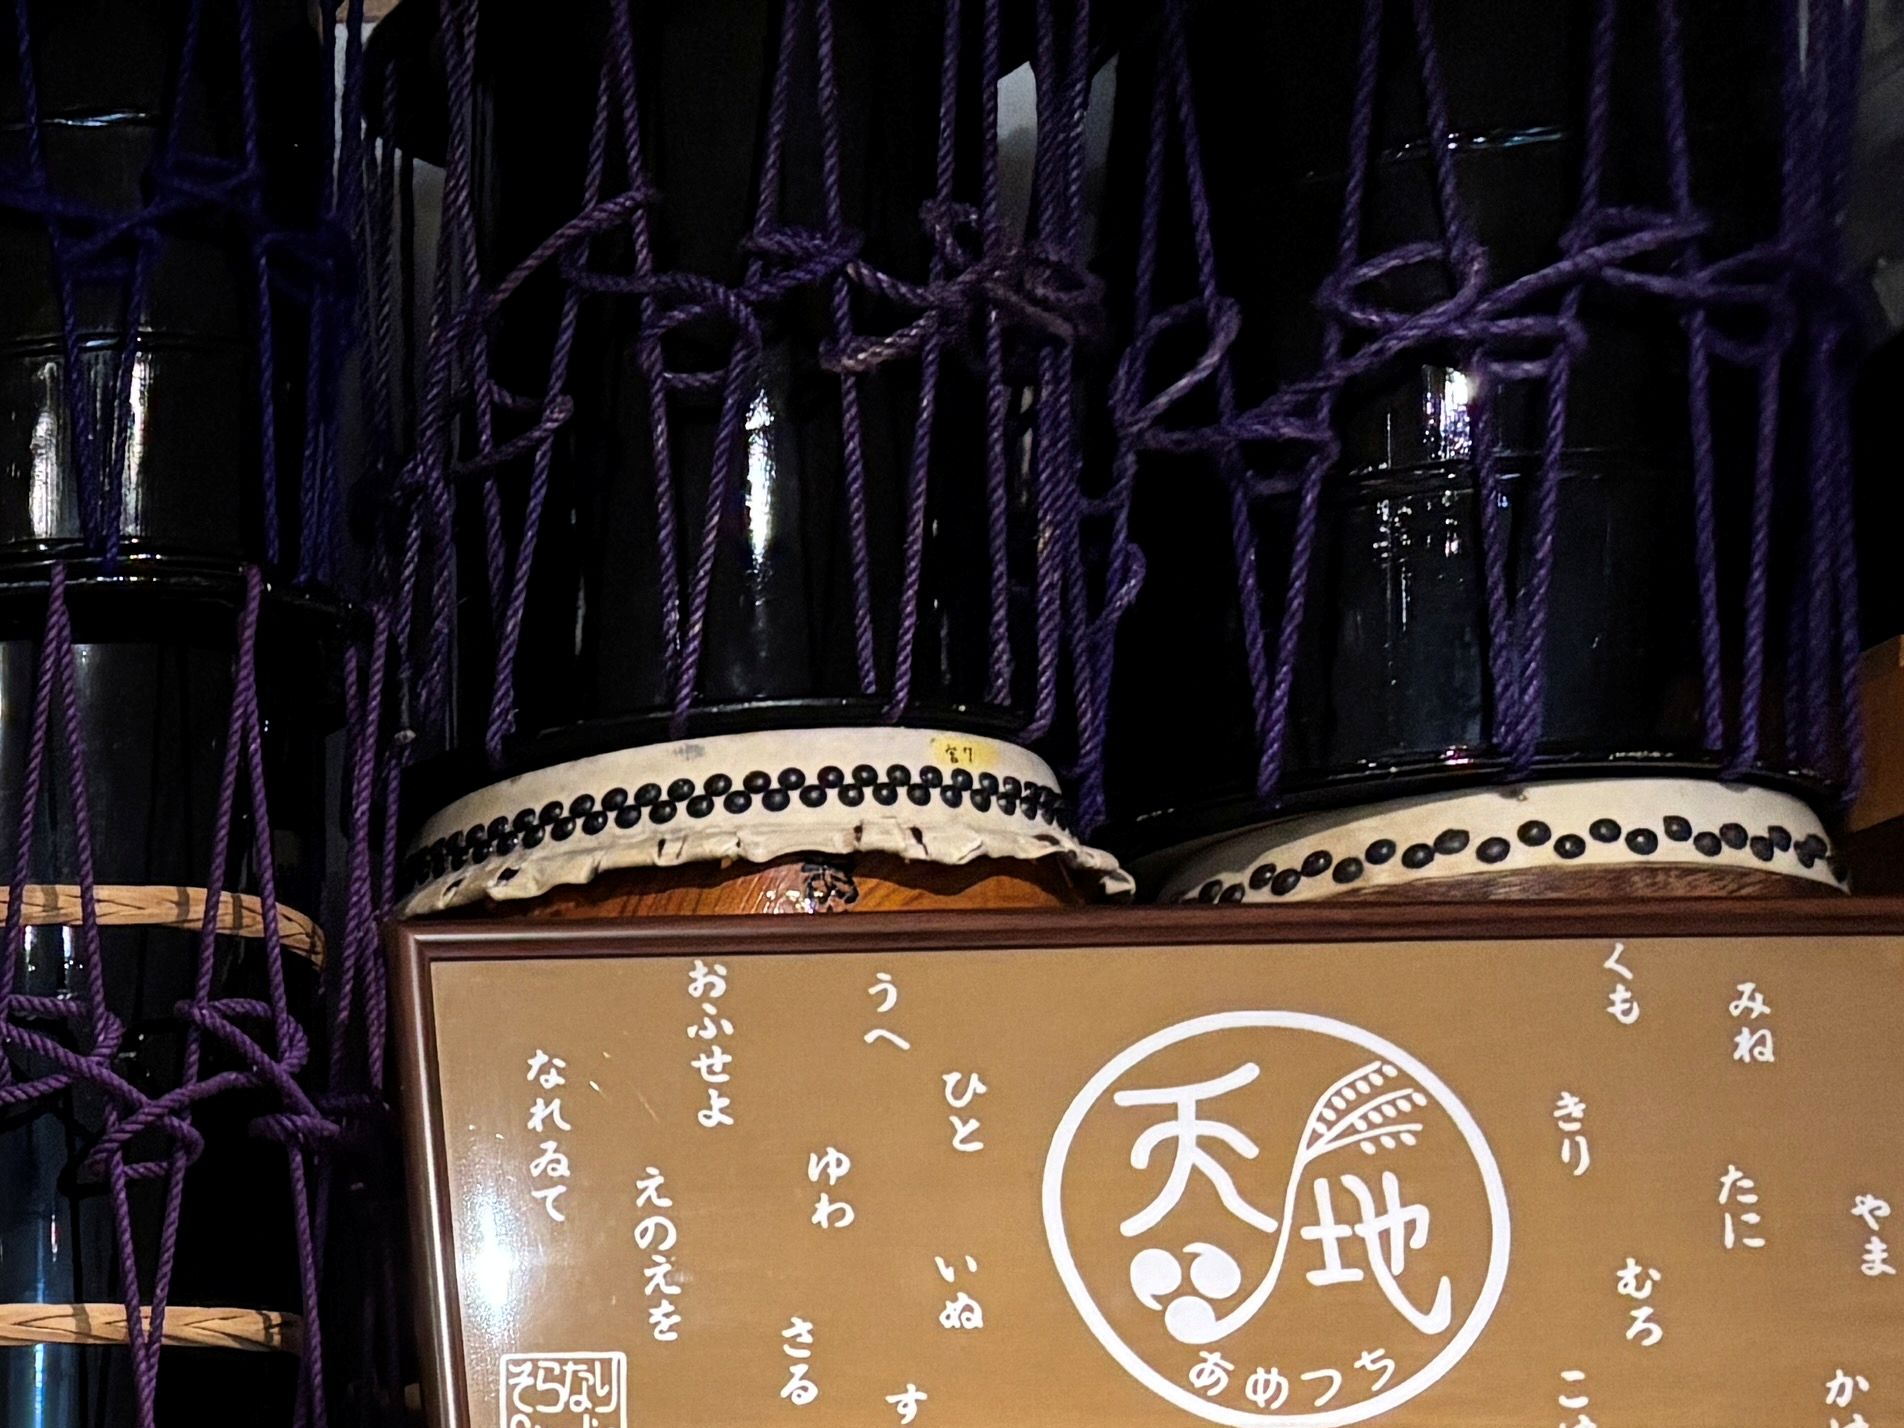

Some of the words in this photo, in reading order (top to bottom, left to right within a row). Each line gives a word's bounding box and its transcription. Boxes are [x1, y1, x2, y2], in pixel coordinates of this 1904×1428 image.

[863, 972, 911, 1050] うへ
[1604, 942, 1640, 1025] くも
[1728, 982, 1775, 1063] みね
[687, 959, 734, 1128] おふせよ
[942, 1071, 988, 1152] ひと
[1553, 1091, 1590, 1176] きり
[807, 1146, 855, 1229] ゆわ
[1718, 1164, 1765, 1249] たに
[633, 1166, 682, 1342] えのえを
[1851, 1194, 1896, 1276] やま
[934, 1255, 984, 1330] いぬ
[1616, 1257, 1663, 1346] むろ
[508, 1360, 617, 1413] そらなり
[780, 1316, 819, 1406] さる
[1189, 1347, 1397, 1408] あめつち
